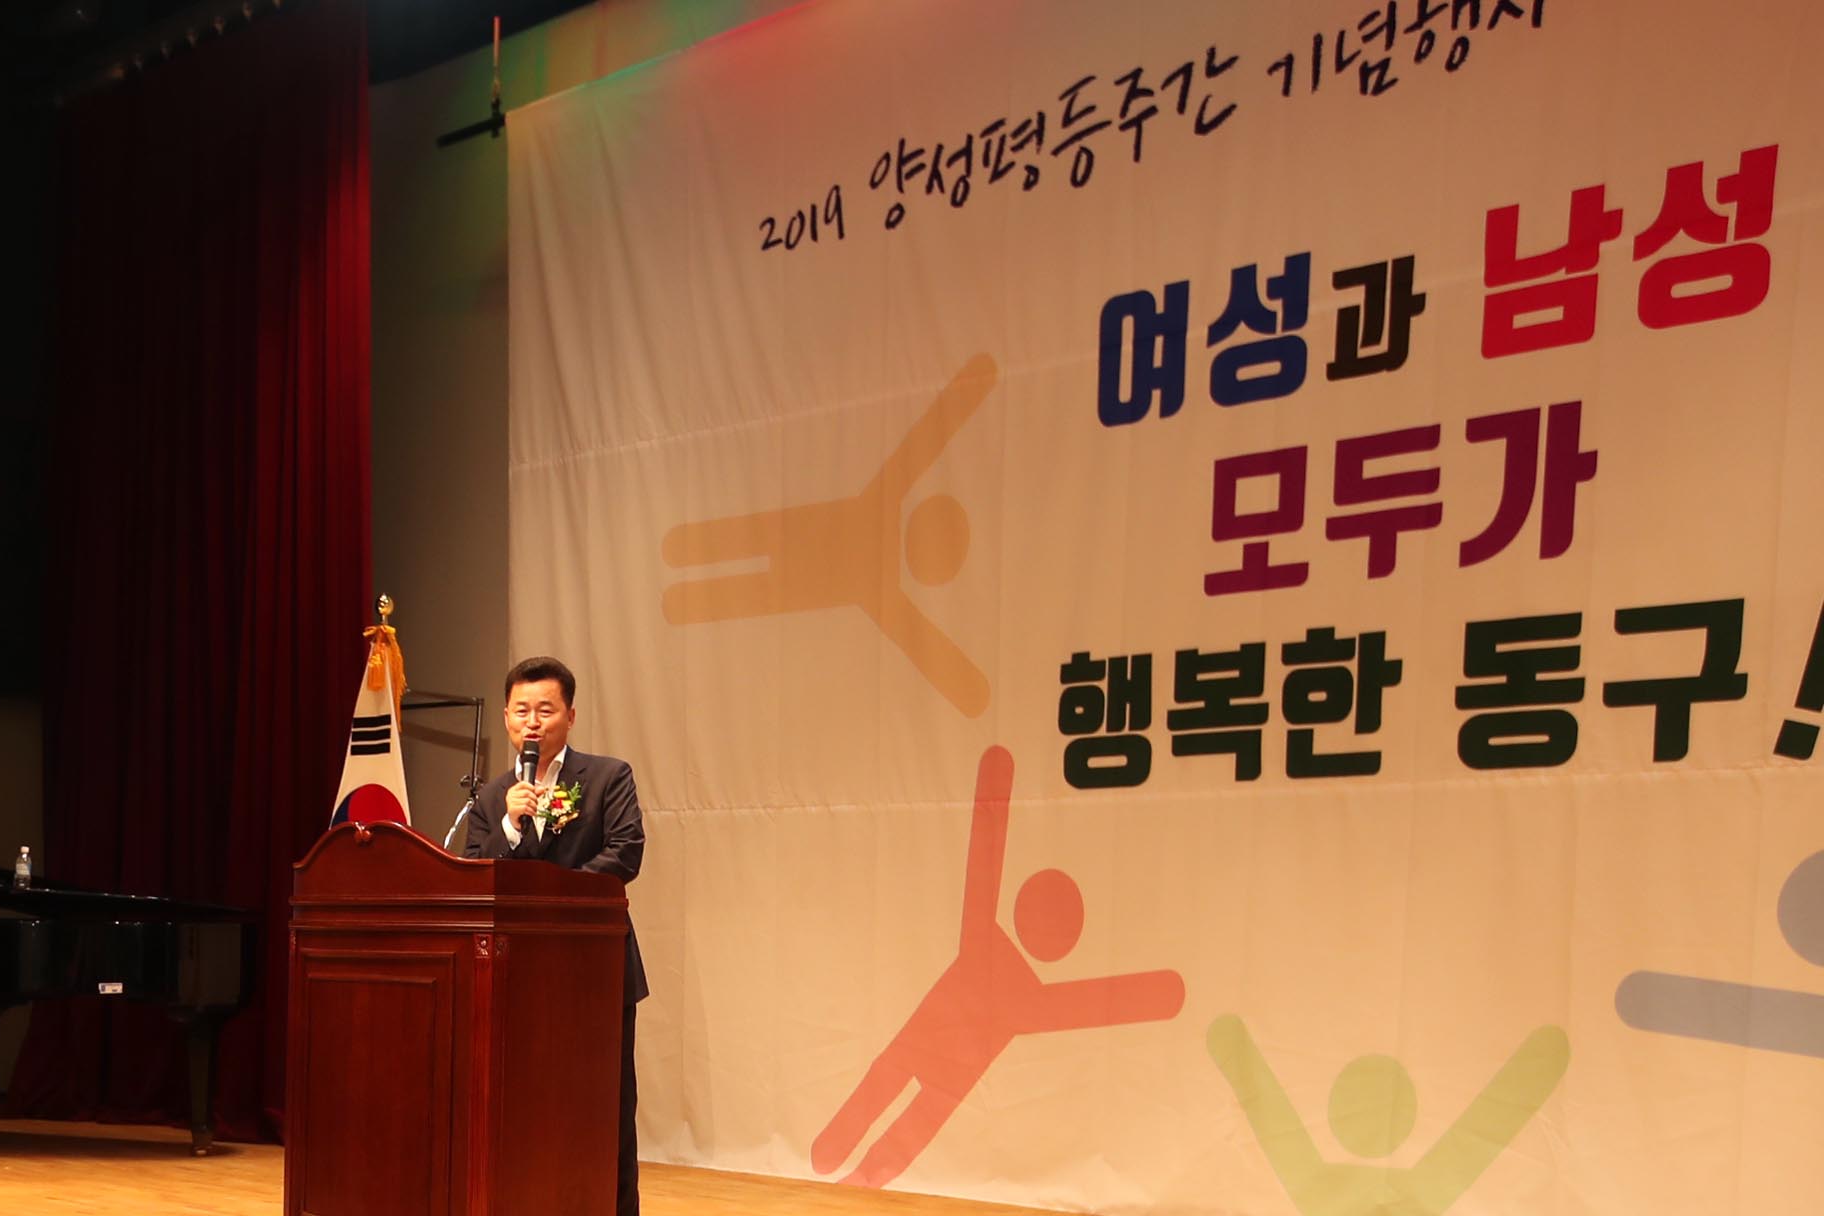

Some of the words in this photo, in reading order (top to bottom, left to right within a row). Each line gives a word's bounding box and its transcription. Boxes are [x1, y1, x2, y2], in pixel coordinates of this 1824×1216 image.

[759, 185, 845, 251] 2019
[869, 45, 1240, 230] 양성평등주간
[1095, 252, 1427, 427] 여성과
[1480, 144, 1780, 360] 남성
[1203, 400, 1599, 597] 모두가
[1057, 626, 1403, 790] 행복한
